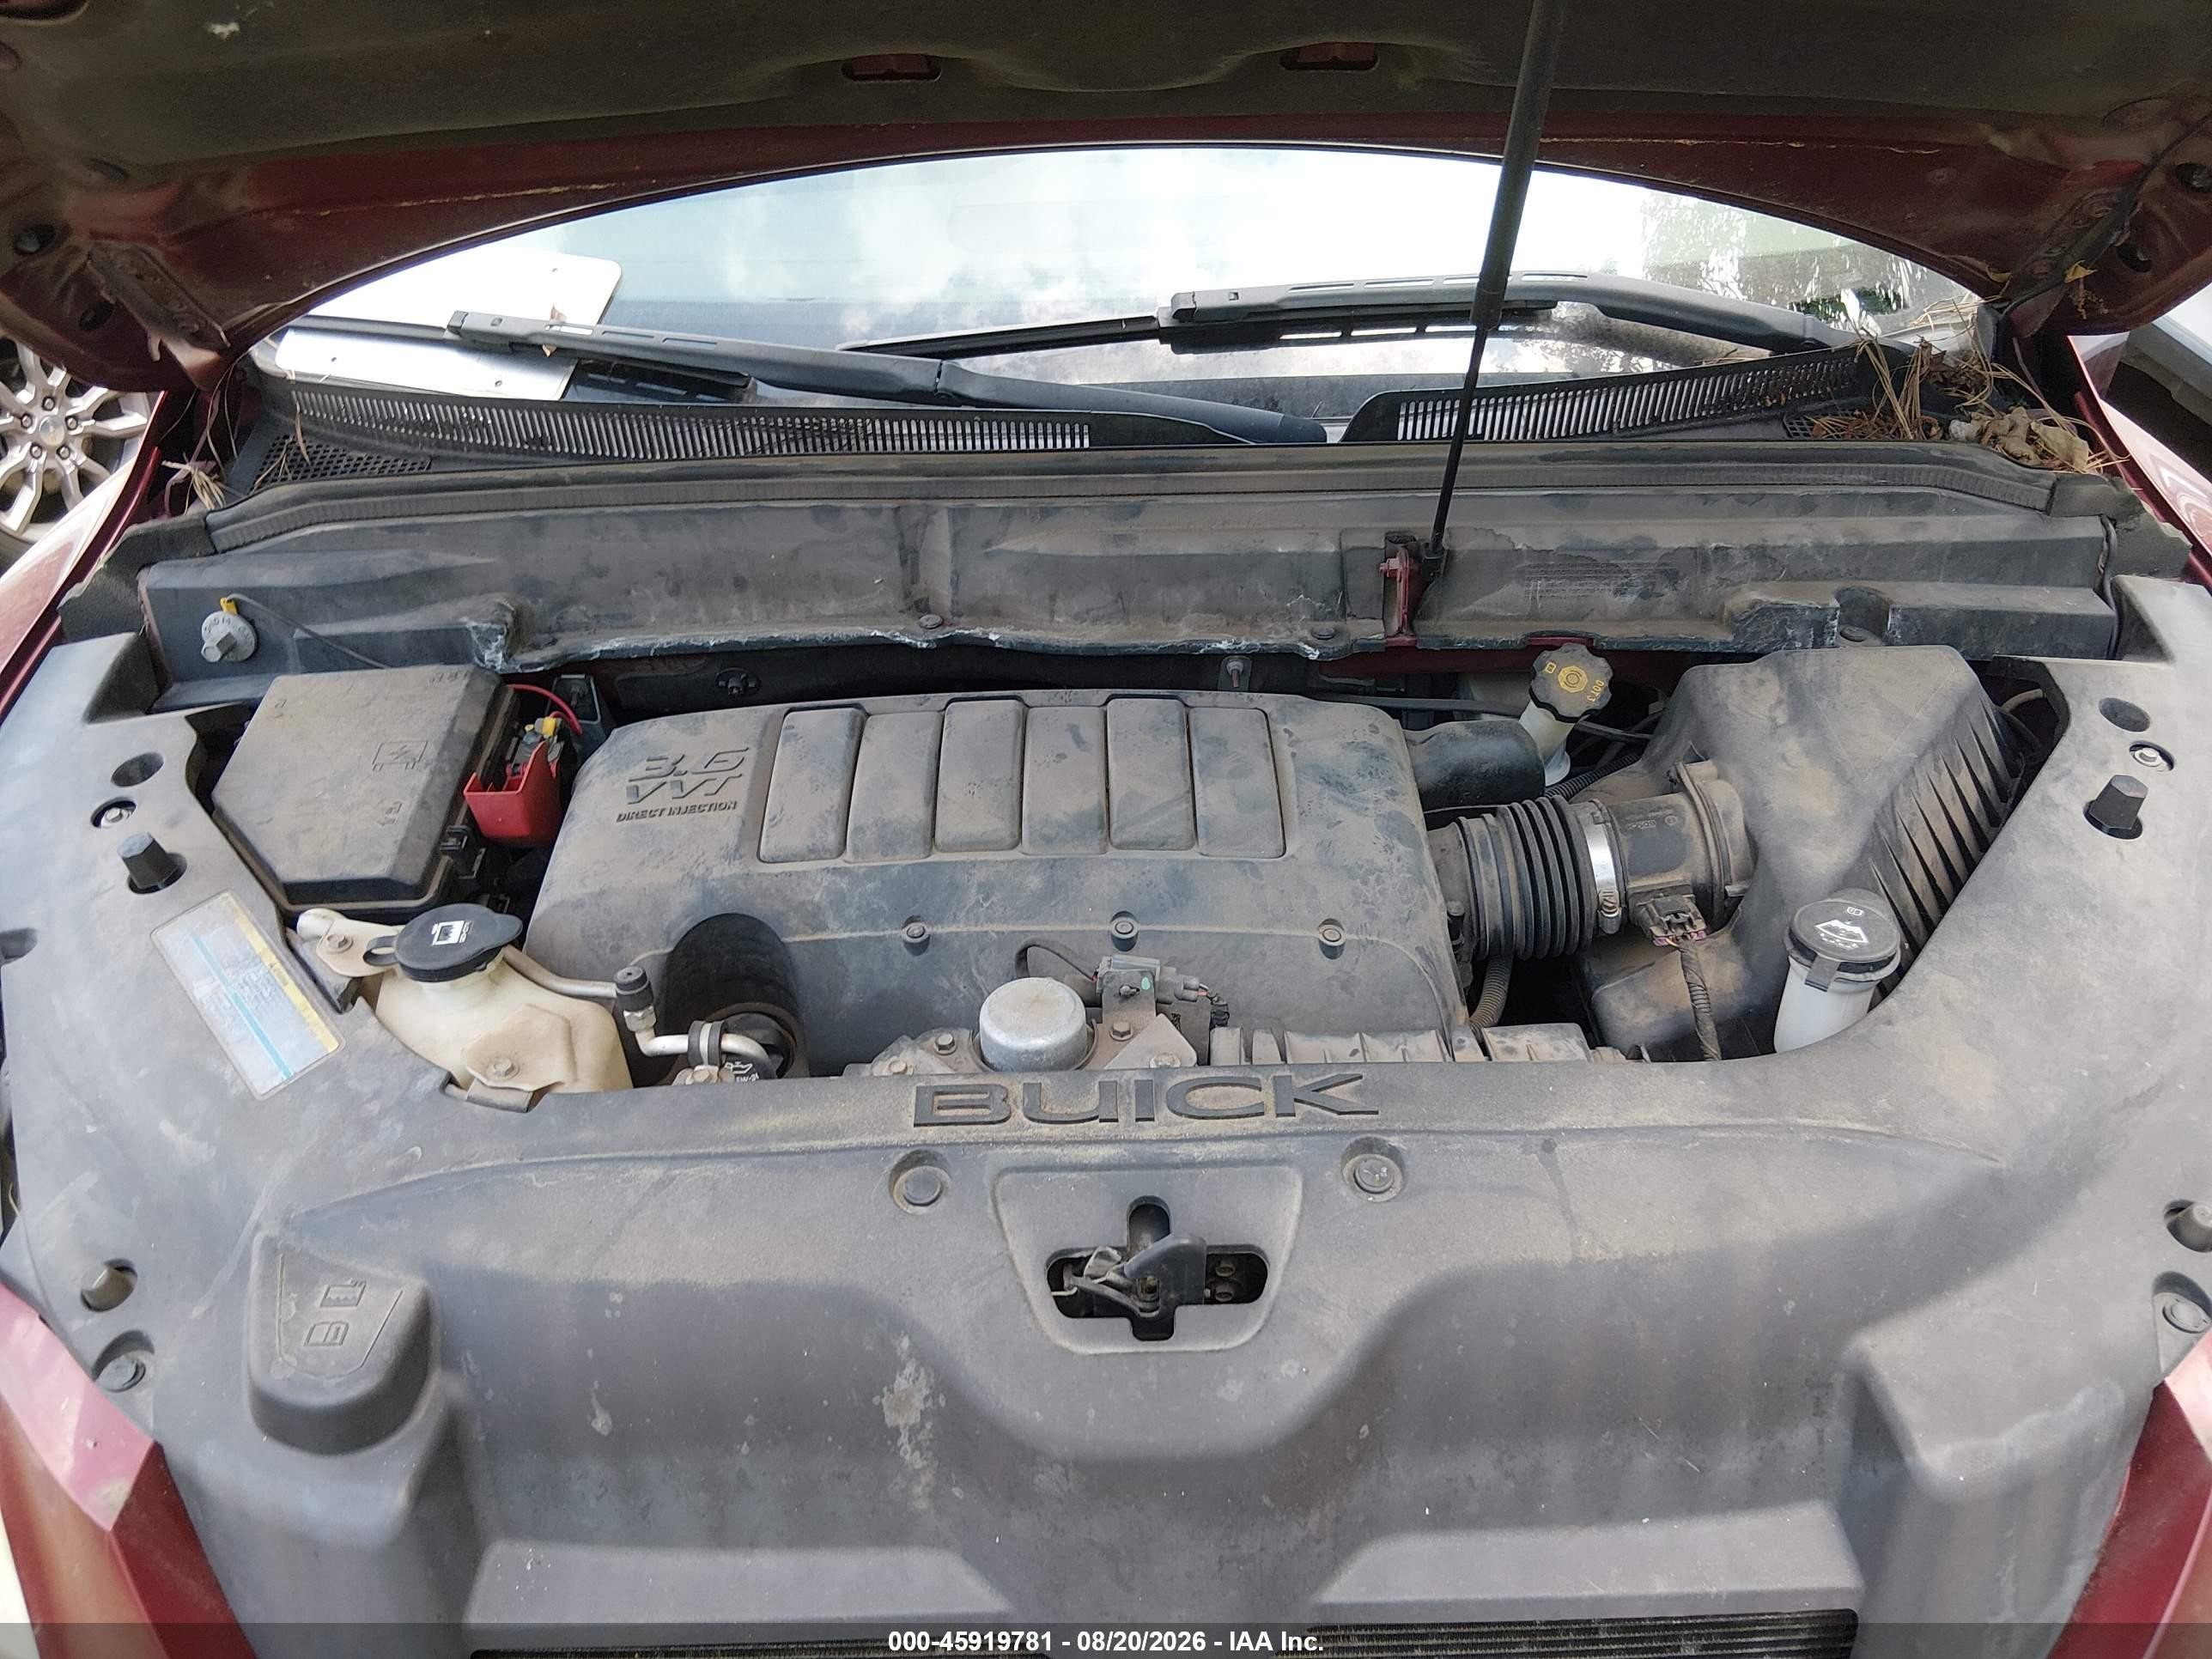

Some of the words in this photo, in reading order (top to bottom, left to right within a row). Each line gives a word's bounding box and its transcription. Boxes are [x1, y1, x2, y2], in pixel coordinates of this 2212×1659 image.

[628, 746, 750, 782] 3.6
[625, 773, 743, 805] VVT
[616, 807, 665, 823] DIRECT
[666, 800, 738, 816] INJECTION
[914, 1073, 1380, 1127] BUICK
